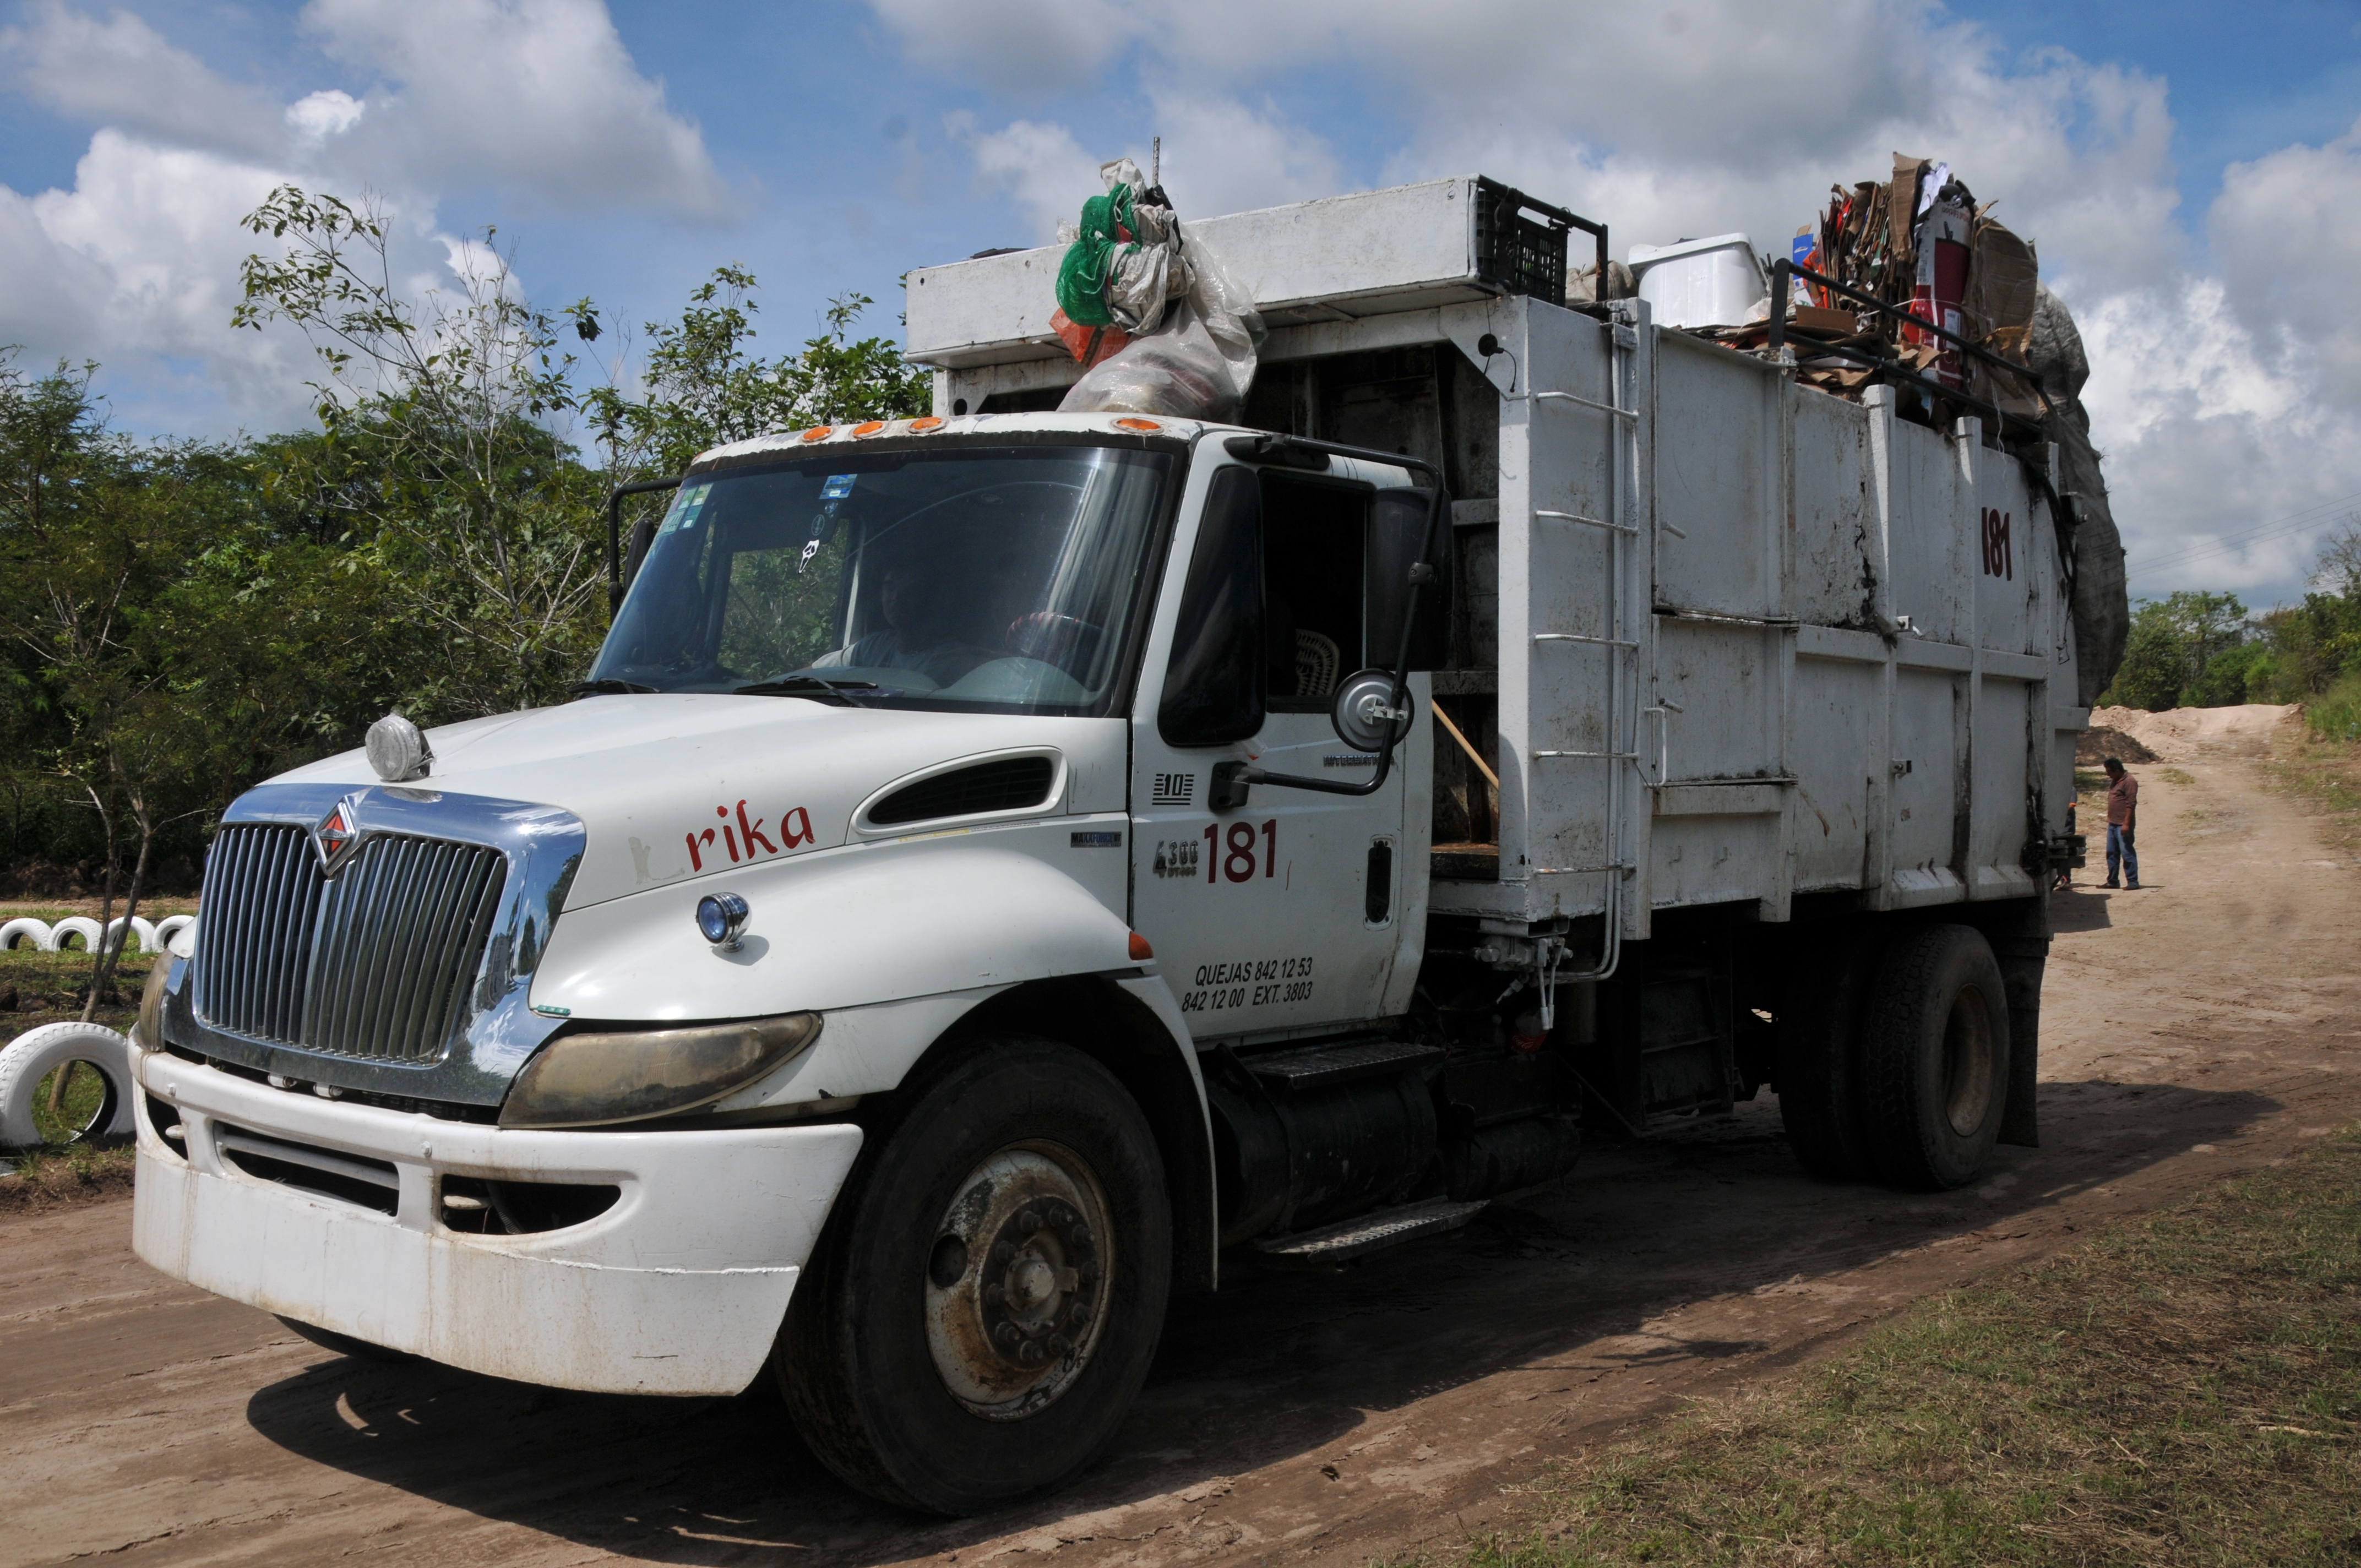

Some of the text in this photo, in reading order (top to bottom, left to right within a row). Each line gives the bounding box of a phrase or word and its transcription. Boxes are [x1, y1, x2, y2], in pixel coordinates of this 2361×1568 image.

[1981, 507, 2012, 581] 181
[1164, 774, 1184, 796] 10
[1153, 840, 1199, 879] 4300
[1204, 819, 1277, 884] 181
[1195, 956, 1313, 987] QUEJAS 842 12 53
[1182, 981, 1313, 1012] 842 12 00 EXT. 3803
